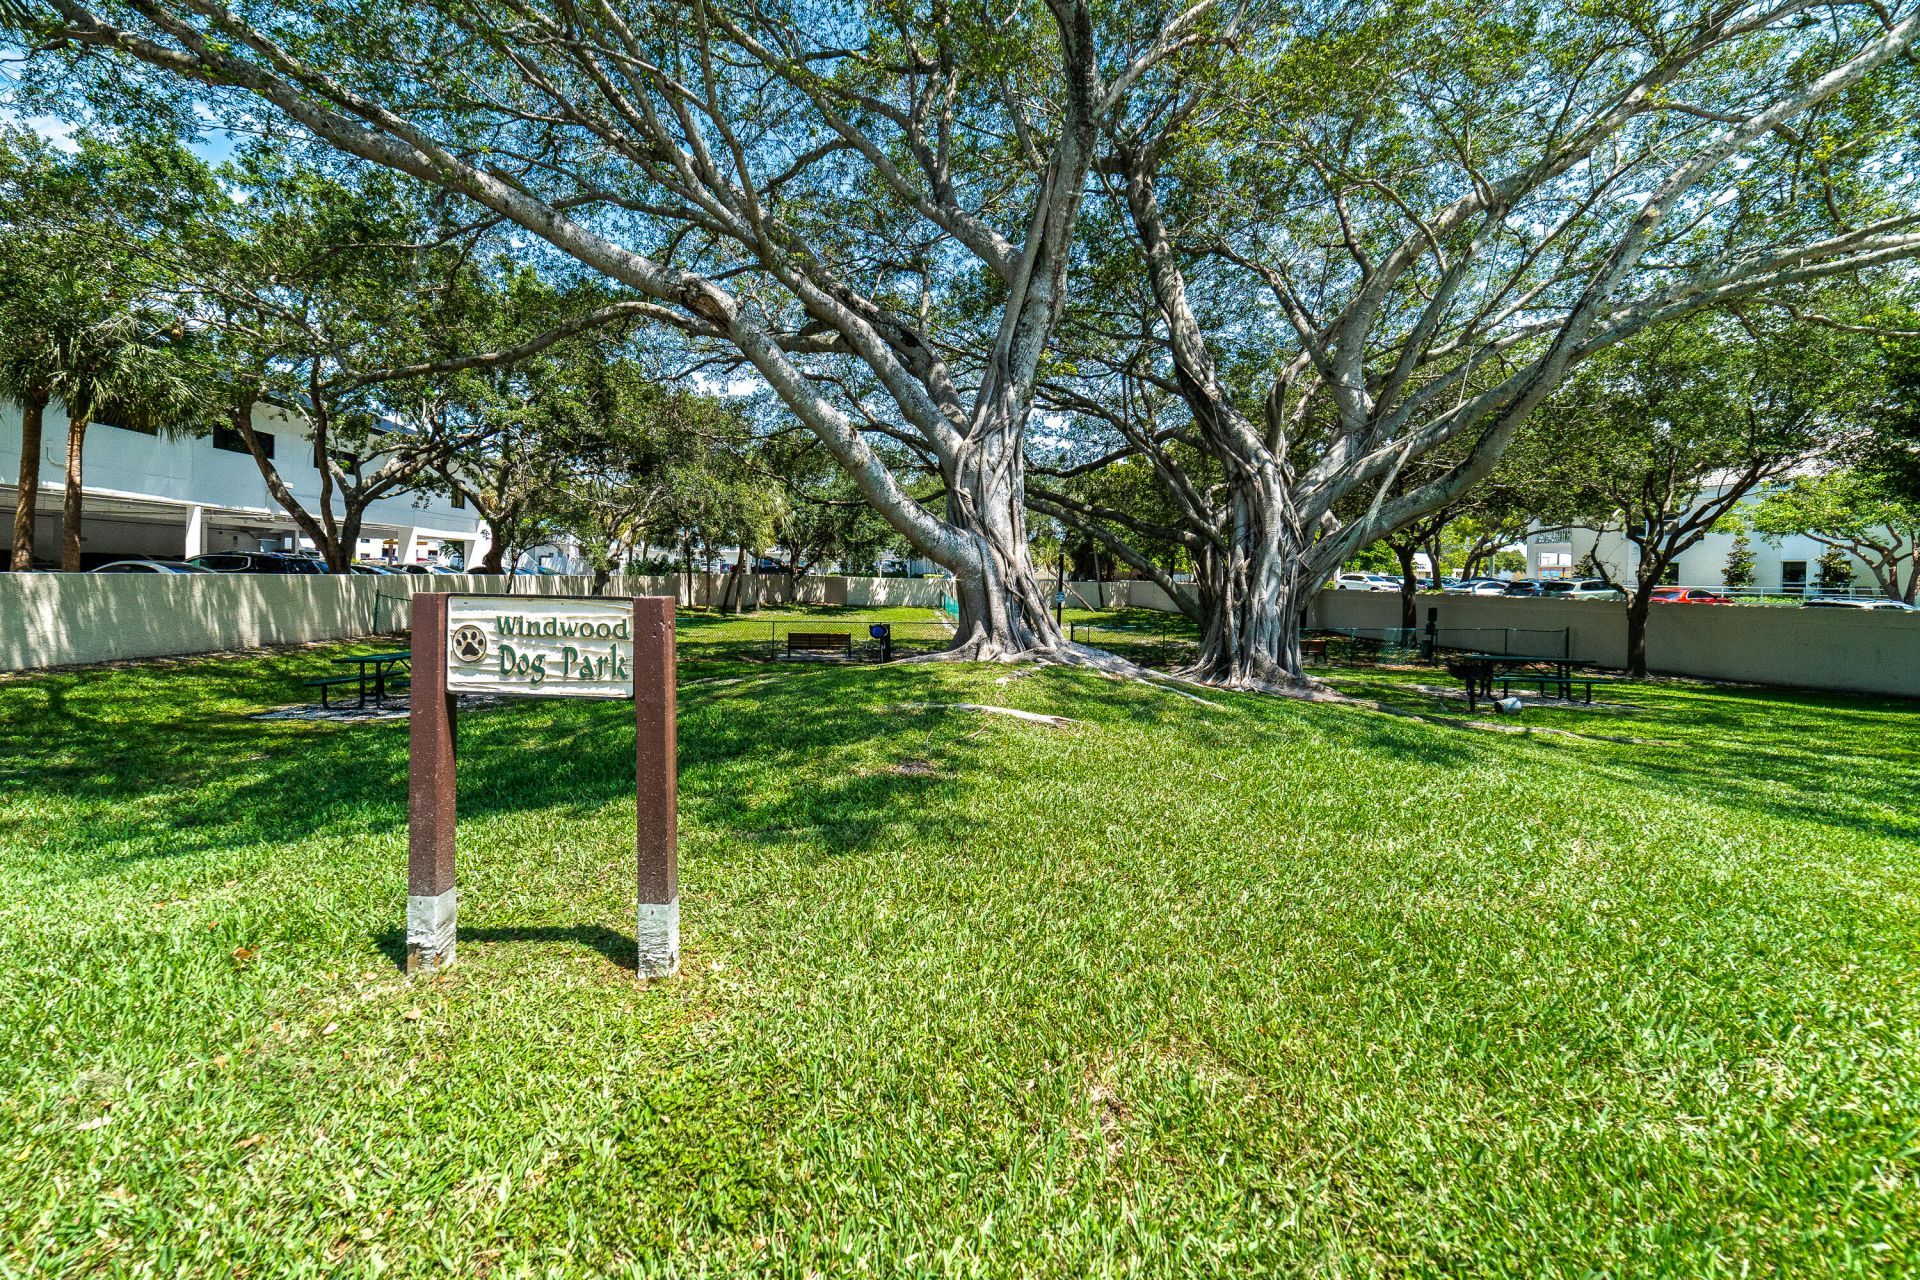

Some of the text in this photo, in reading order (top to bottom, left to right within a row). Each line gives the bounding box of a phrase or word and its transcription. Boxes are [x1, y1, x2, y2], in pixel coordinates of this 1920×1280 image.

[496, 615, 629, 639] Windwood
[498, 643, 628, 685] Dog Park
